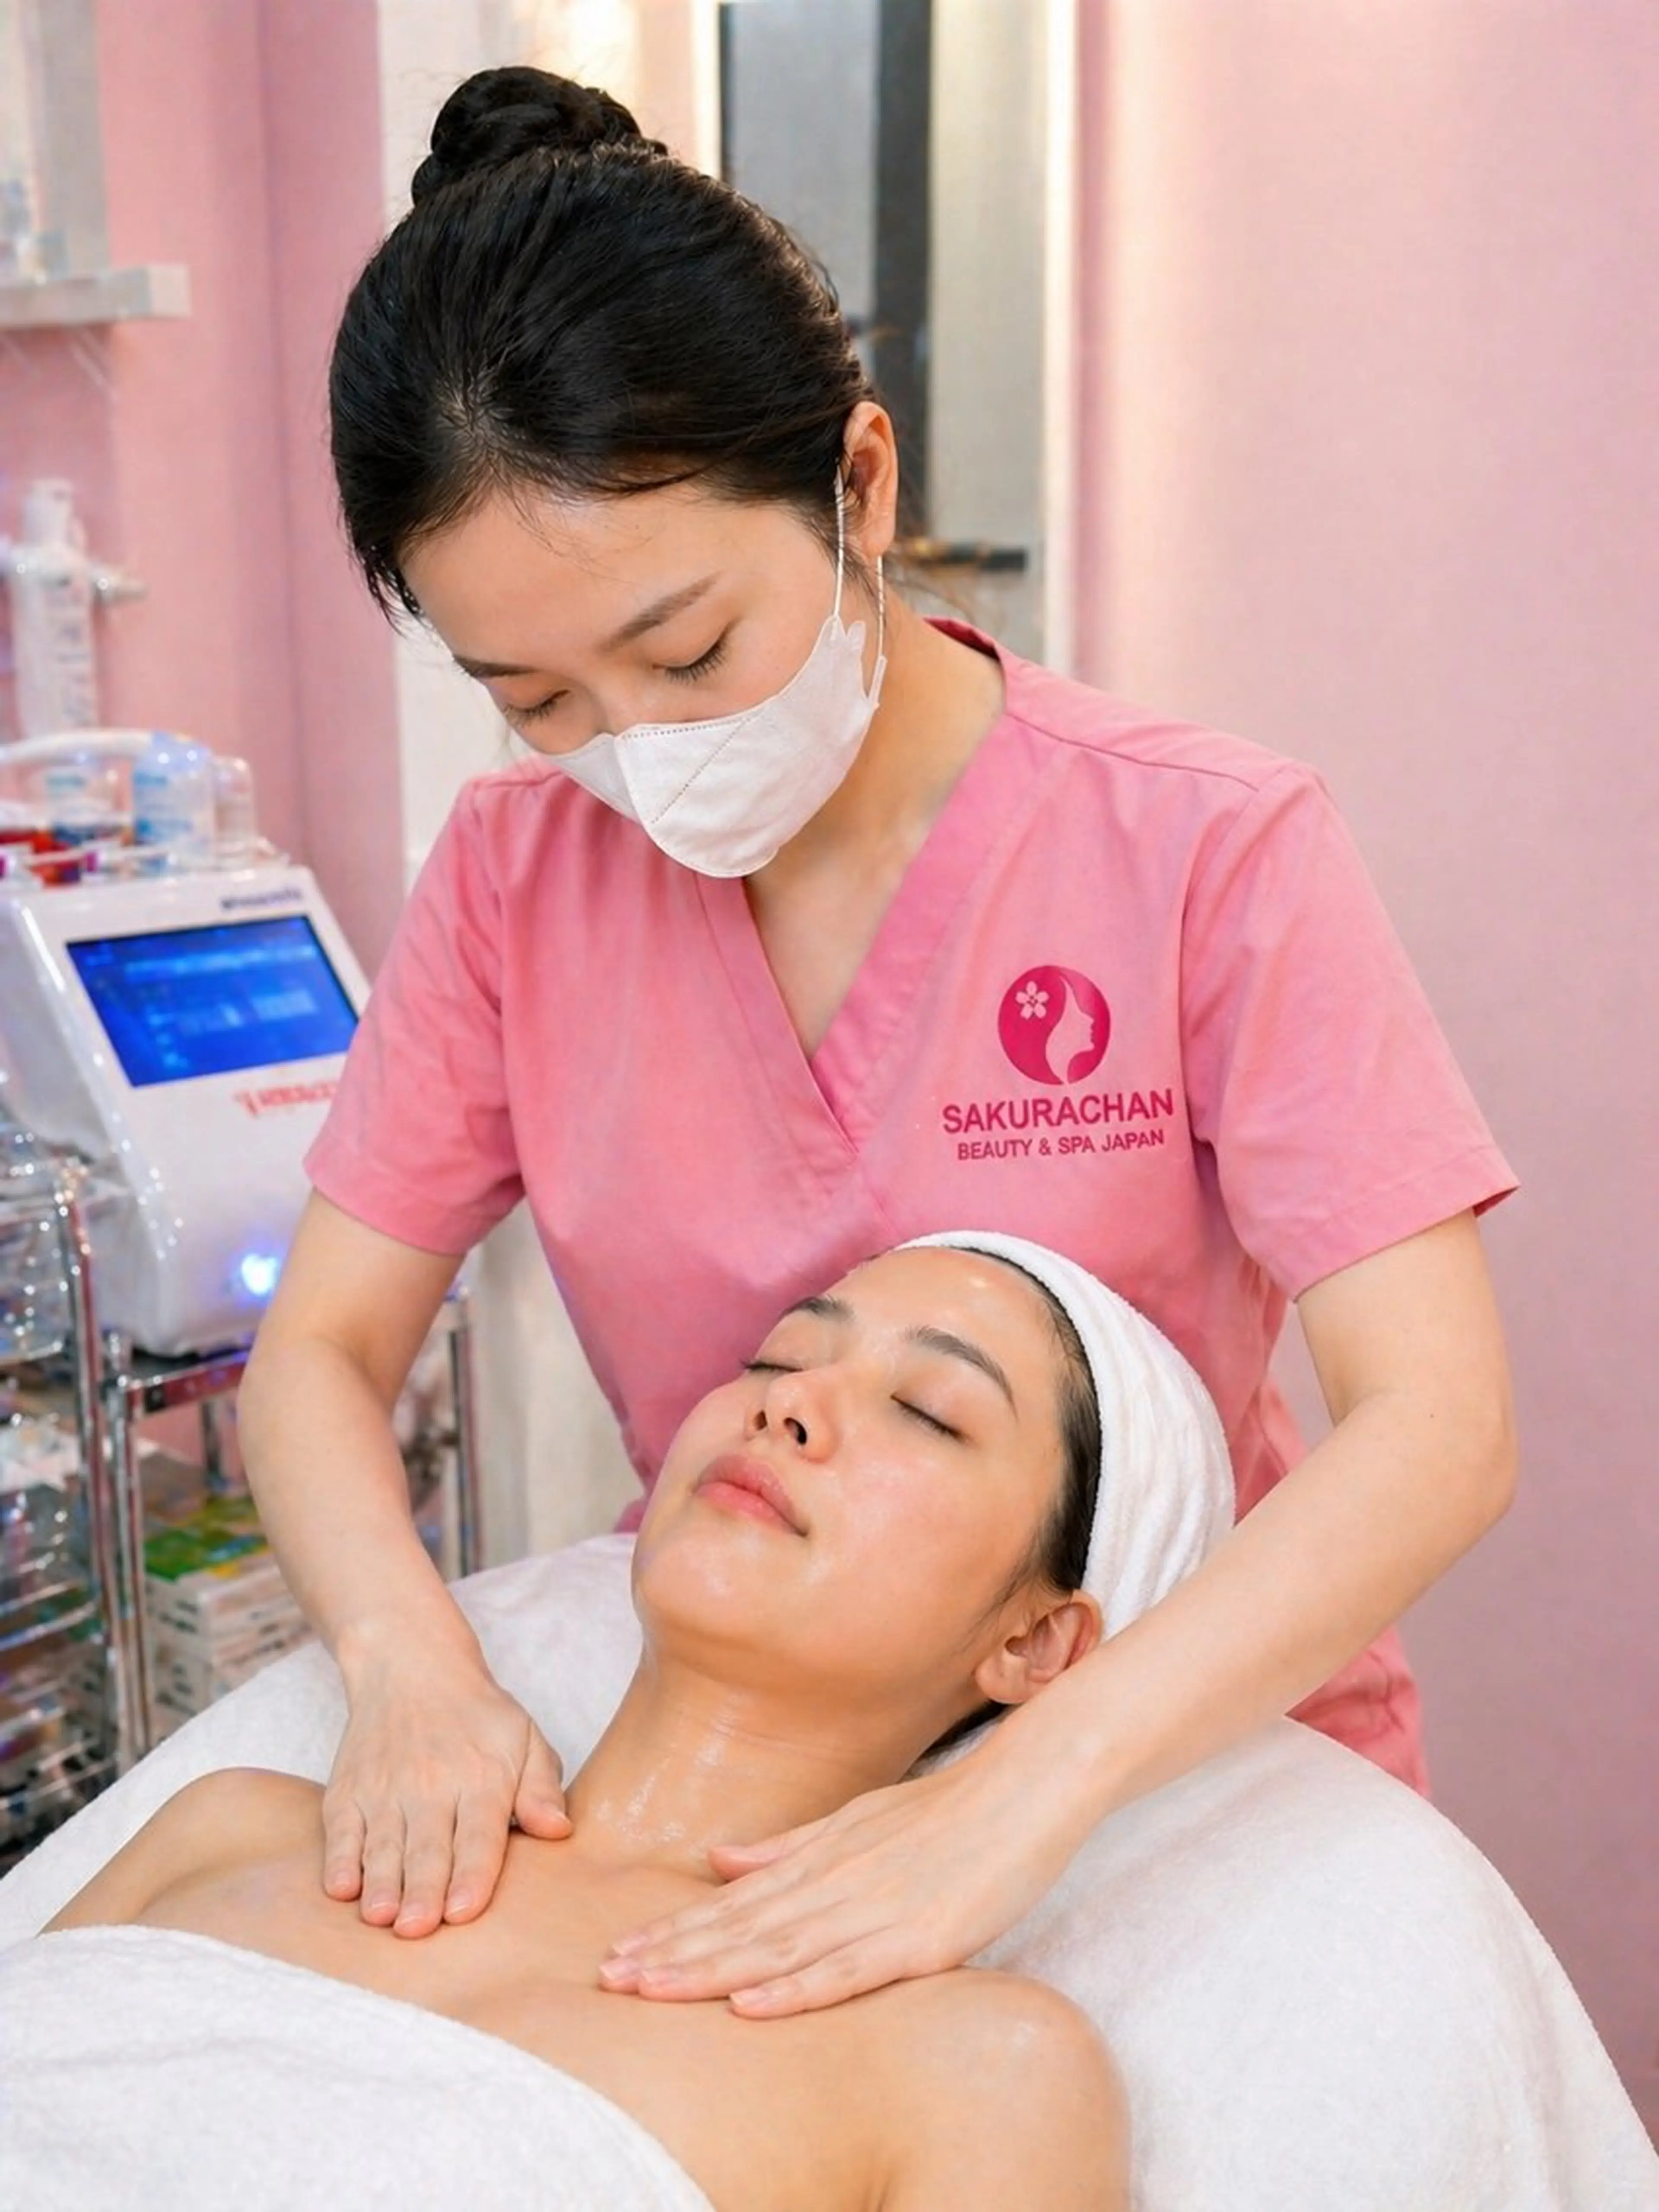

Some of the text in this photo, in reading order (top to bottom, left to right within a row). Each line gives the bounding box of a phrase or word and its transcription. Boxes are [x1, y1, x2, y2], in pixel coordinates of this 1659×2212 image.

[942, 1088, 1174, 1134] SAKURACHAN
[957, 1129, 1164, 1160] BEAUTY & SPA JAPAN
